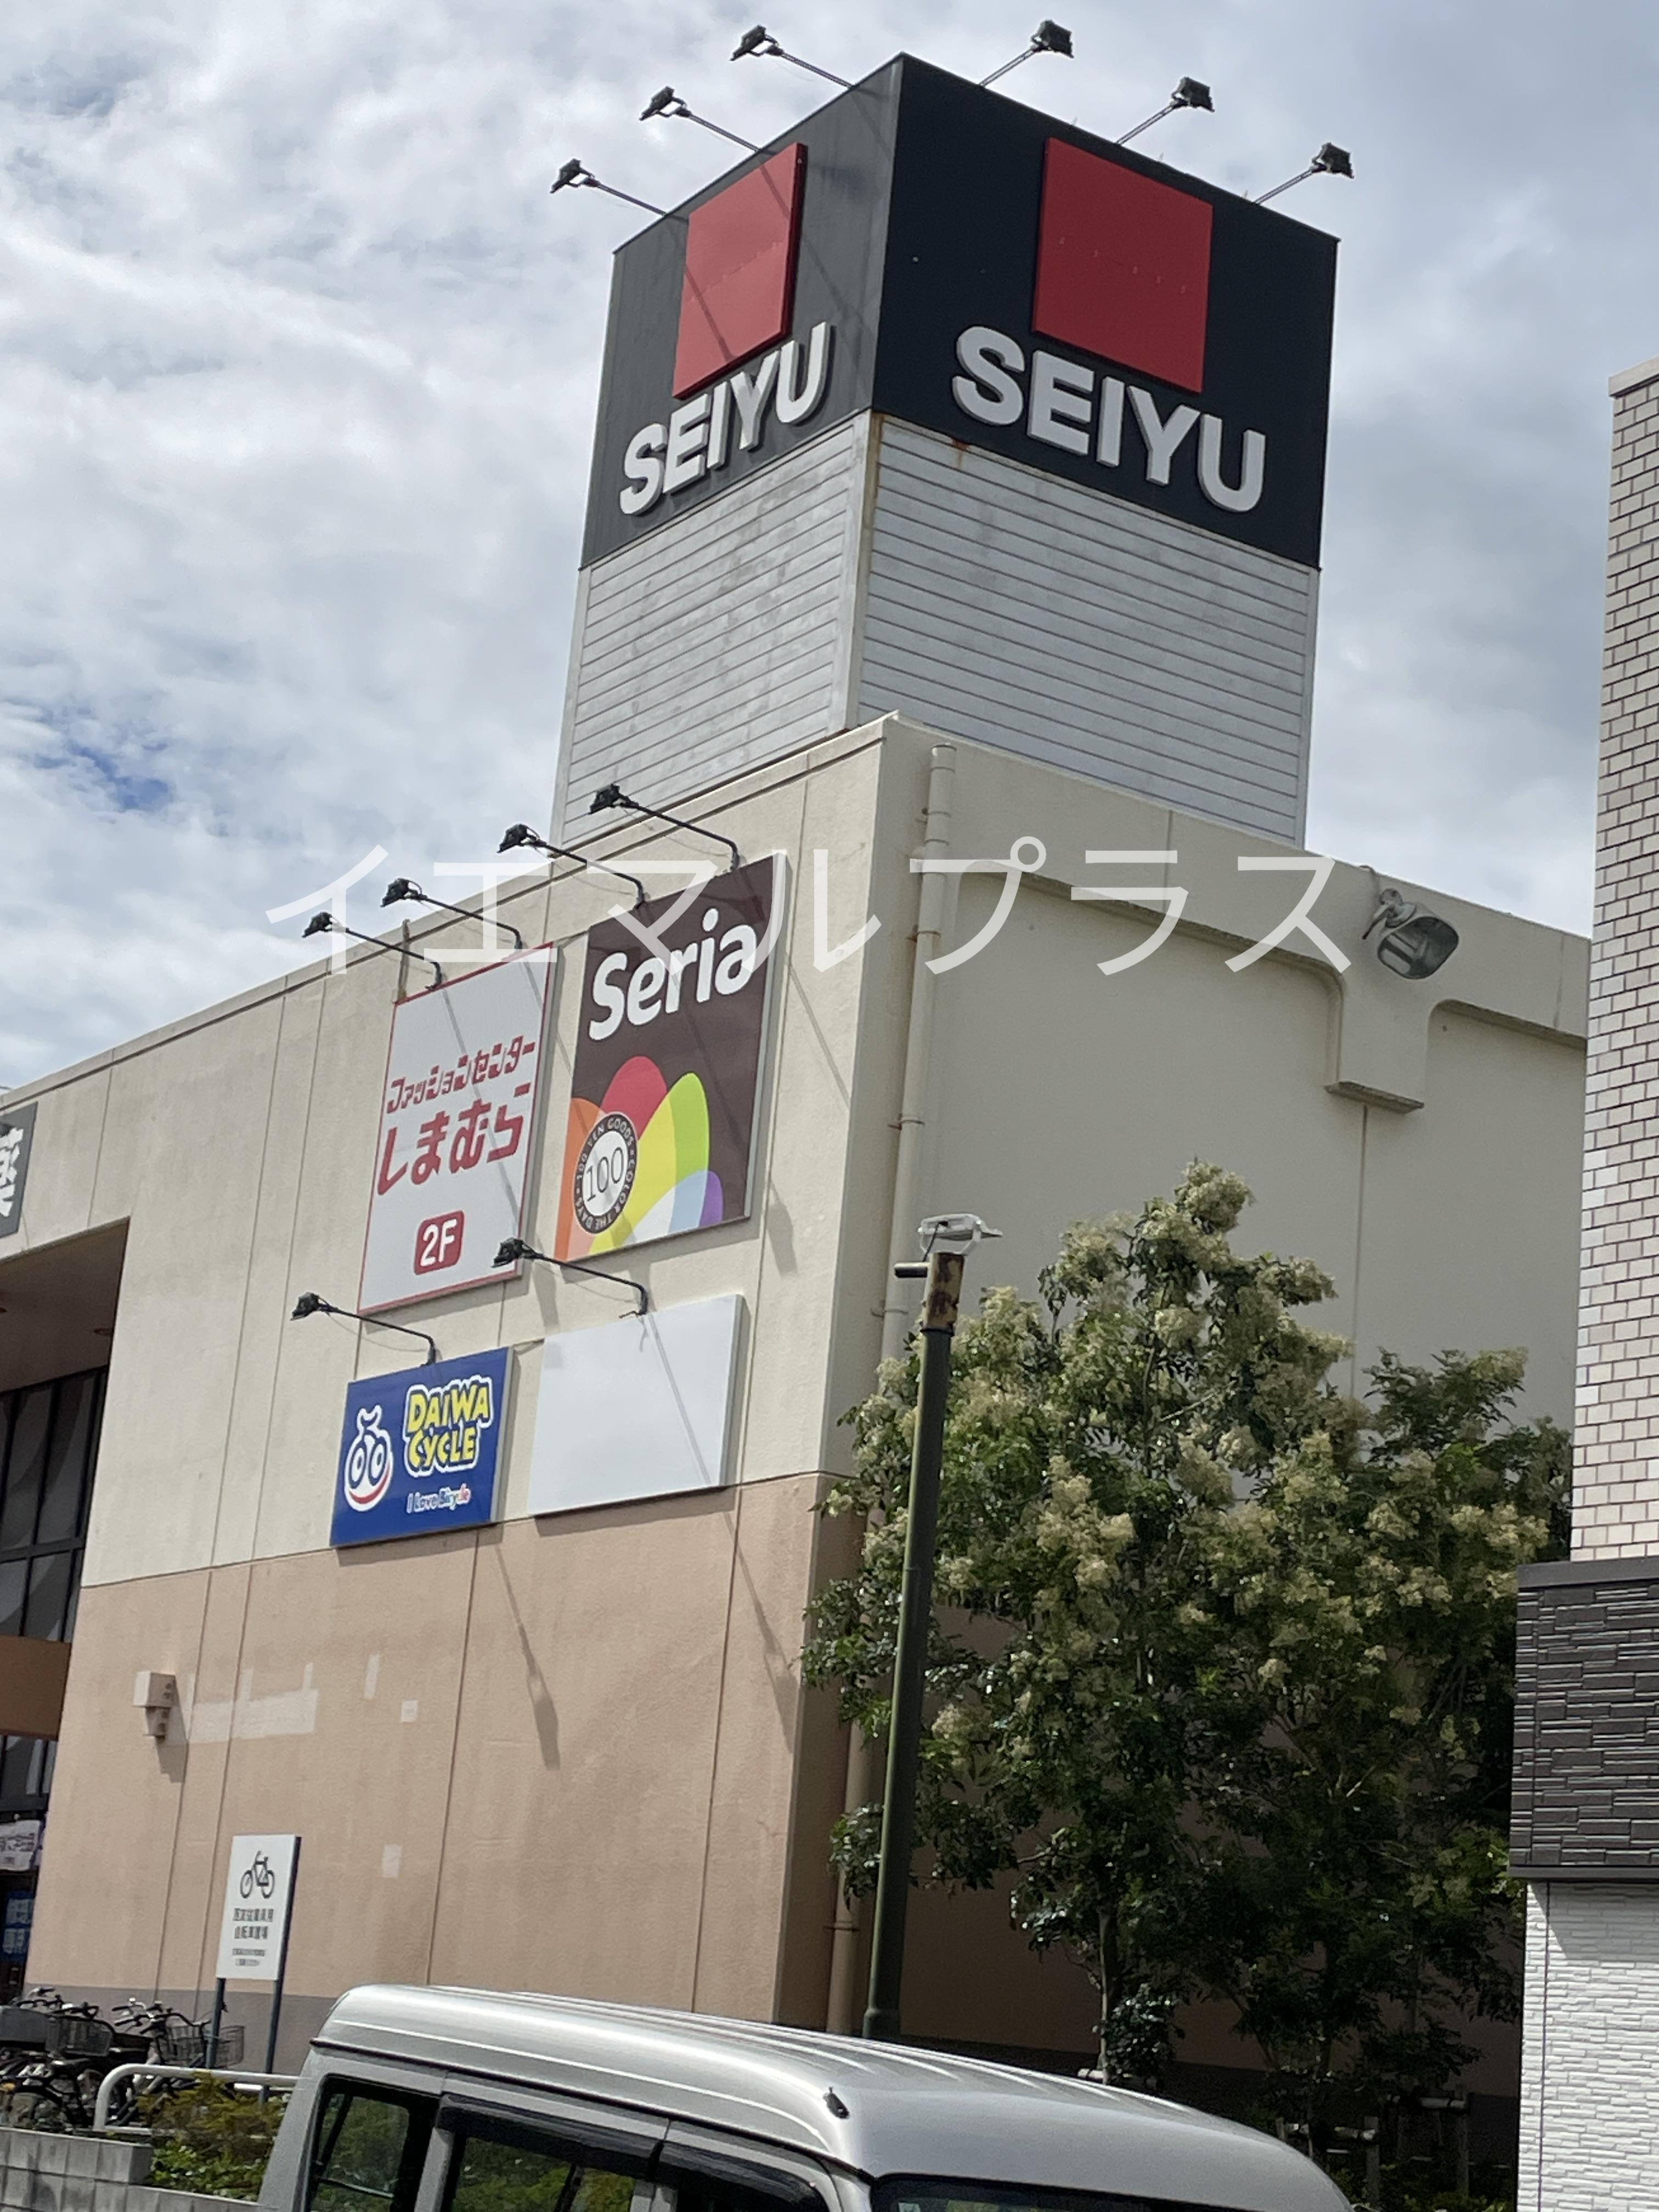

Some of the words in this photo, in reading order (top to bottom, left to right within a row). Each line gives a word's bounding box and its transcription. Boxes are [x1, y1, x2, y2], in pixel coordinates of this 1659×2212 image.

[619, 321, 832, 516] SEIYU
[952, 326, 1266, 512] SEIYU
[589, 909, 757, 1040] Seria
[386, 1035, 536, 1114] ファッションセンター
[377, 1082, 531, 1195] しまむら
[586, 1146, 624, 1203] 100
[420, 1218, 458, 1267] 2F
[407, 1381, 490, 1434] DAIWA
[408, 1427, 477, 1468] CYCLE
